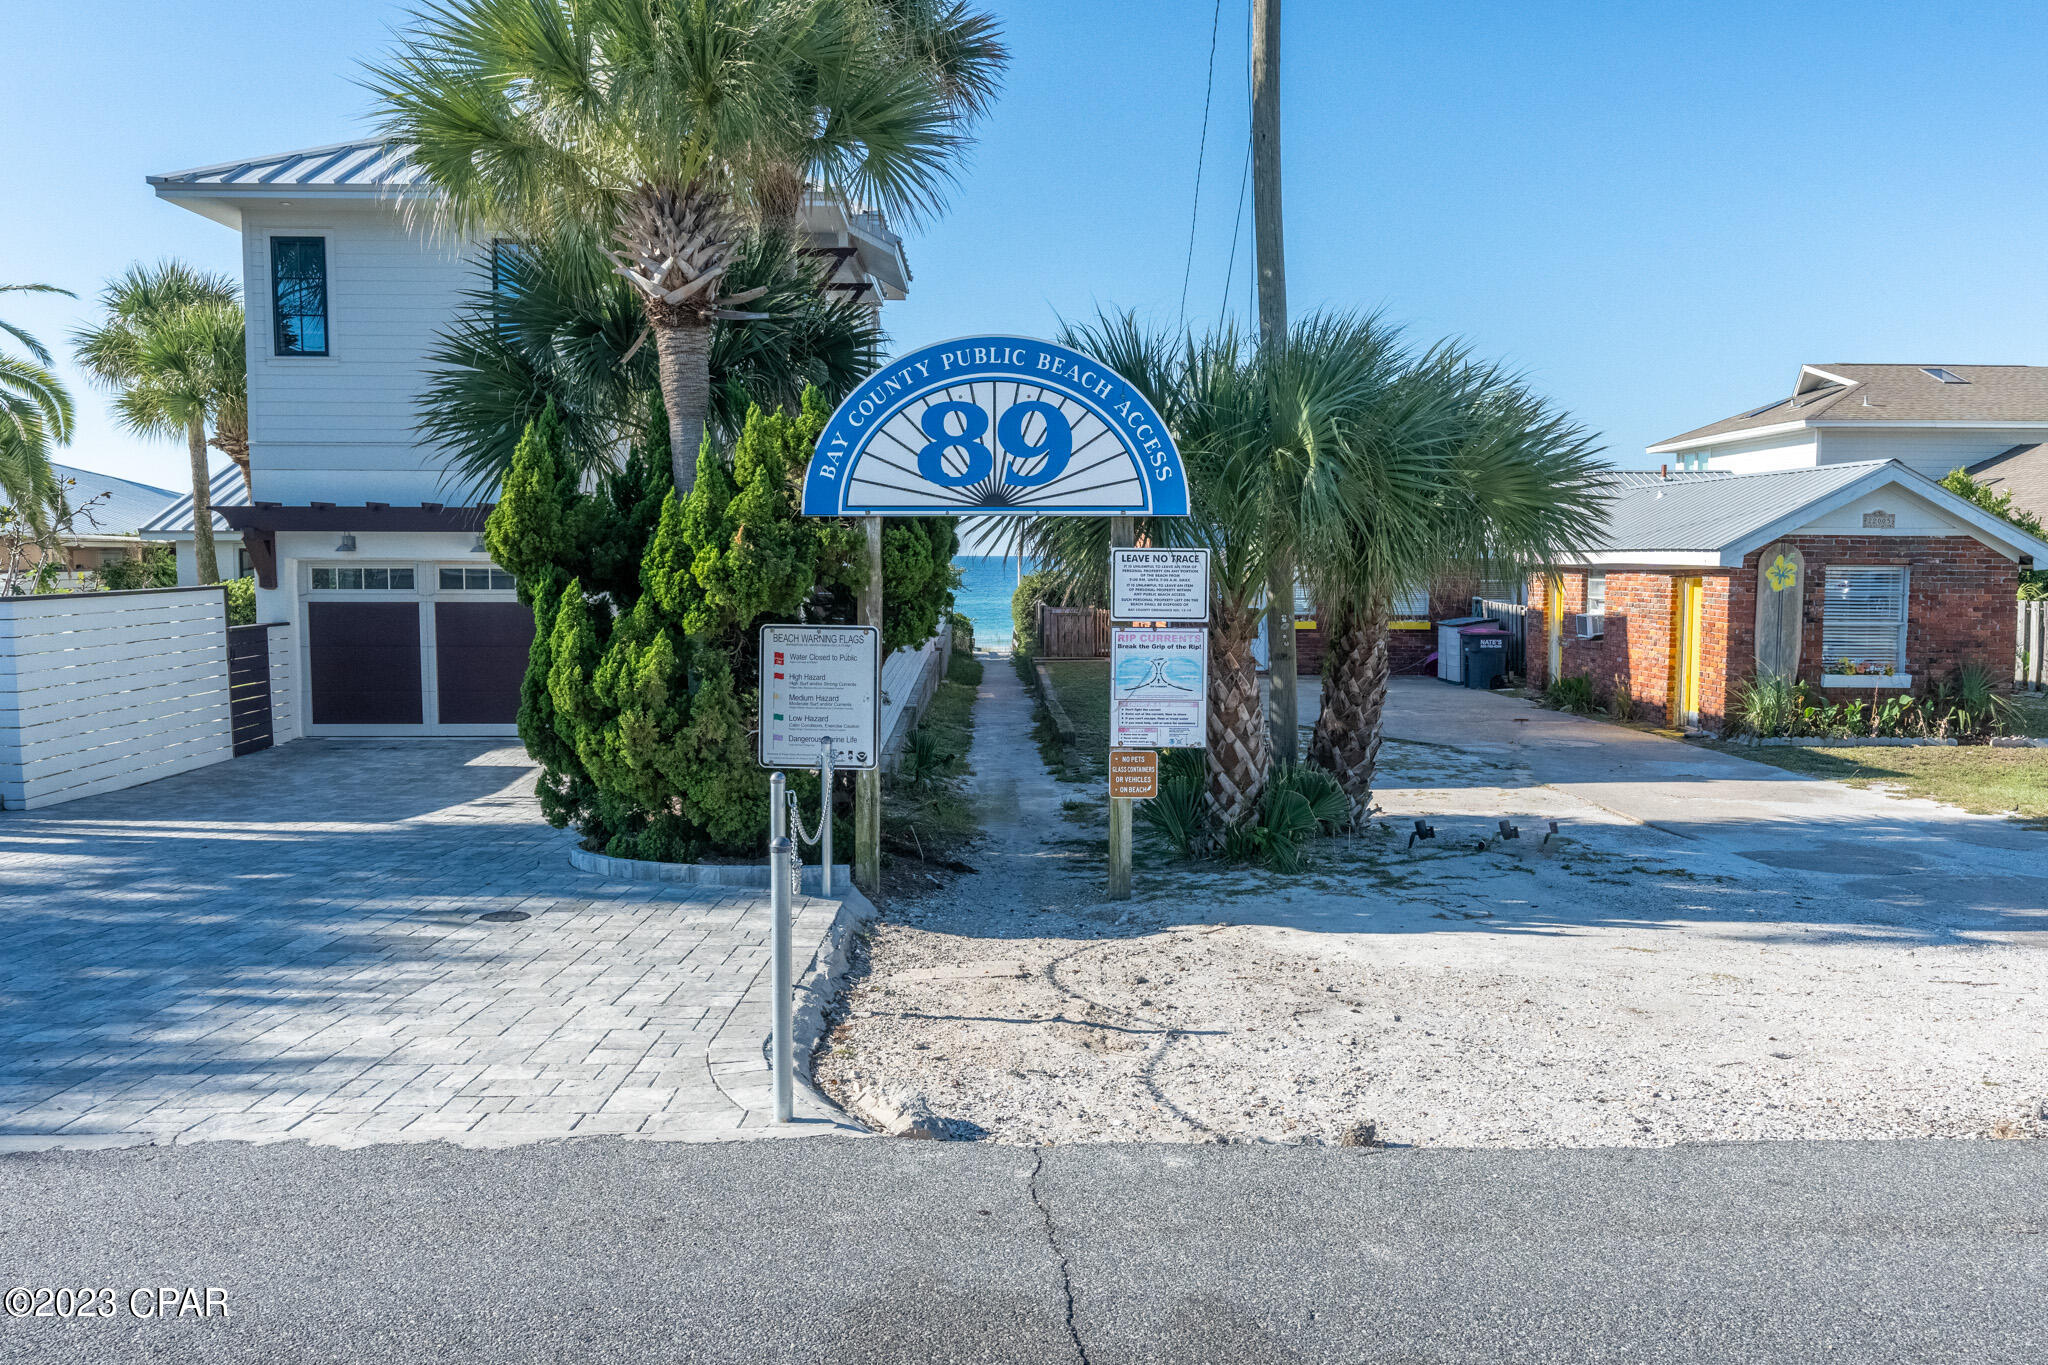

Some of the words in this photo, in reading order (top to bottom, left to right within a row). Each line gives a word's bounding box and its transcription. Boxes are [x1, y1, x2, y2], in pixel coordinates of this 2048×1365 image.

[819, 433, 851, 481] BAY
[848, 360, 932, 426] COUNTY
[941, 347, 1027, 370] PUBLIC
[1036, 353, 1113, 399] BEACH
[1114, 399, 1172, 481] ACCESS
[917, 401, 1073, 486] 89
[773, 634, 799, 642] BEACH
[801, 634, 837, 643] WARNING
[839, 635, 864, 644] FLAGS
[1118, 634, 1136, 642] RIP
[789, 735, 821, 743] Dangerous
